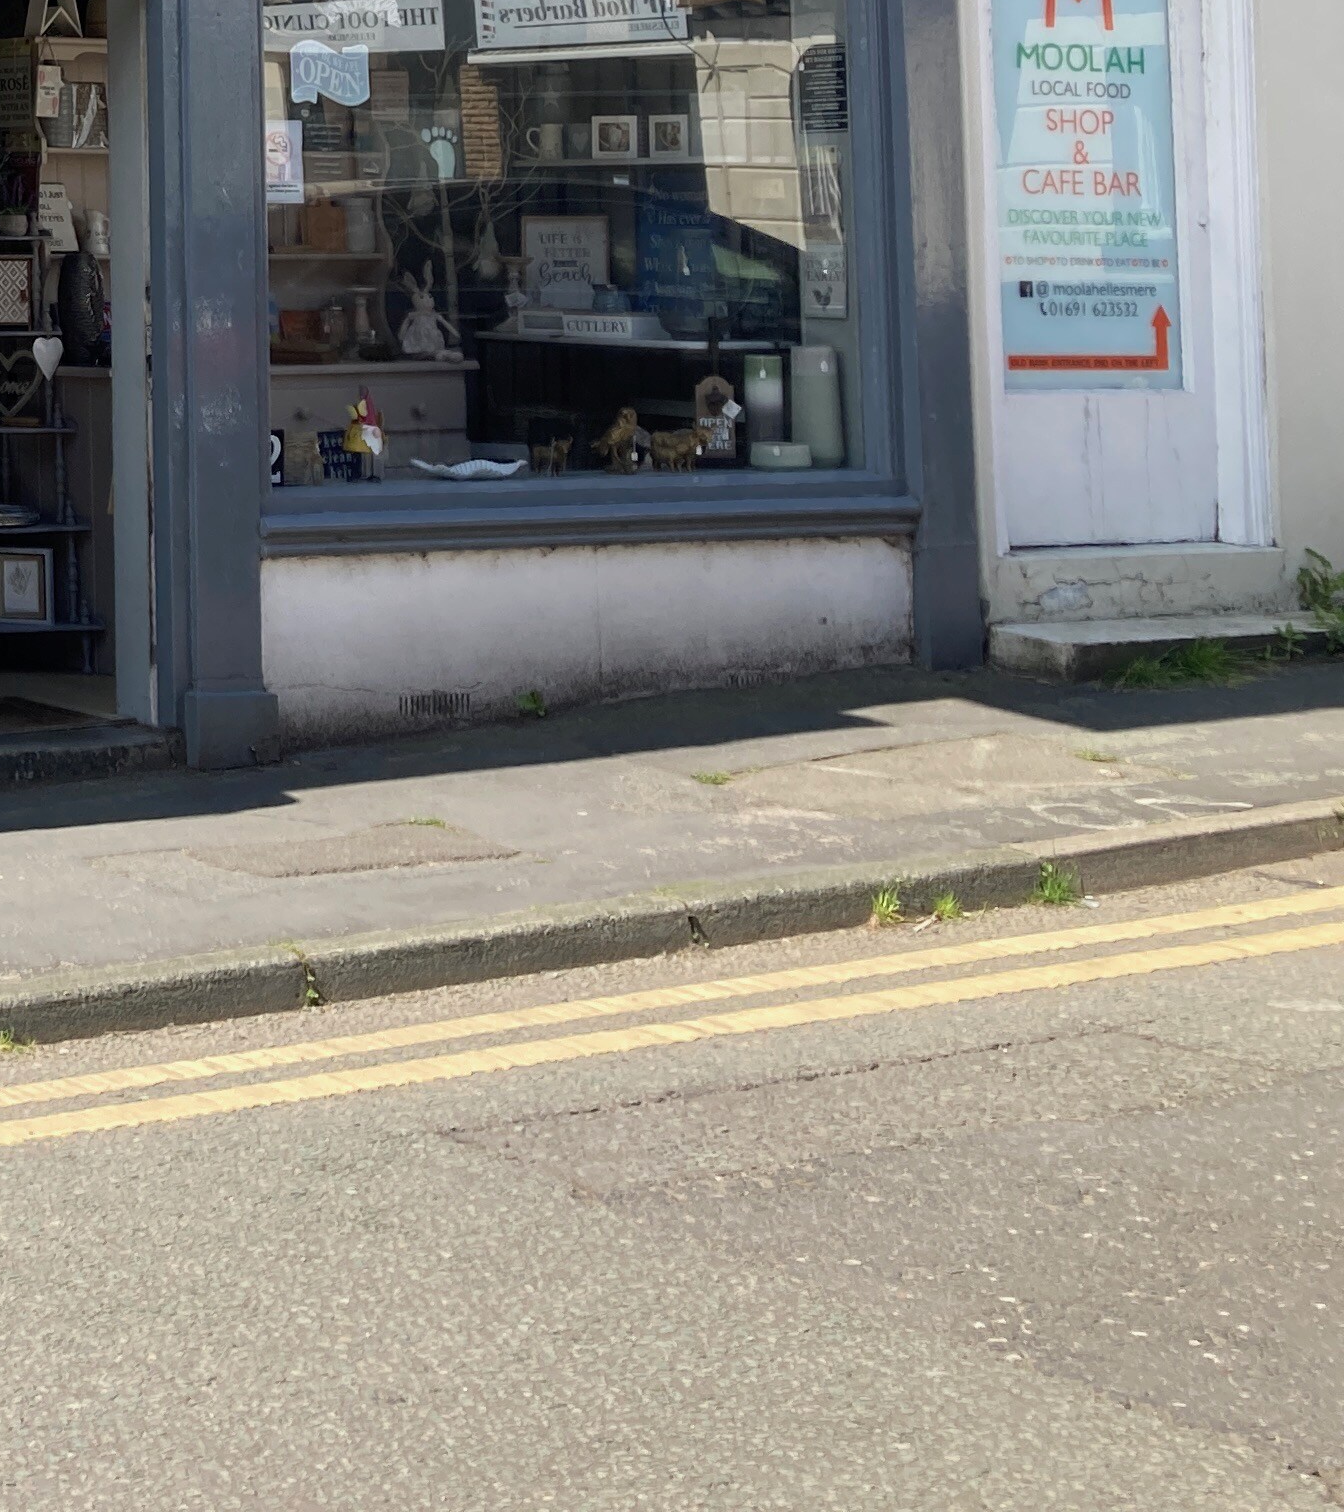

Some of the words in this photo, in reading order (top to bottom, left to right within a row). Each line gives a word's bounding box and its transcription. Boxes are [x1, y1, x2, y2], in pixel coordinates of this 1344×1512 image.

[1016, 42, 1145, 75] MOOLAH
[299, 57, 362, 97] OPEN
[1031, 79, 1084, 97] LOCAL
[1086, 81, 1131, 99] FOOD
[1046, 108, 1115, 135] SHOP
[1073, 140, 1091, 165] &
[1022, 168, 1085, 195] CAFE
[1093, 171, 1143, 197] BAR
[1007, 208, 1079, 225] DISCOVER
[1079, 208, 1124, 226] YOUR
[1126, 211, 1162, 227] NEW
[539, 232, 568, 245] LIFE
[1023, 229, 1103, 247] FAVOURITE
[1104, 231, 1149, 248] PLACE
[1053, 281, 1157, 298] moolahellesmere
[1049, 300, 1087, 317] 01691
[1091, 301, 1139, 318] 623532
[566, 318, 628, 334] CUTLERY
